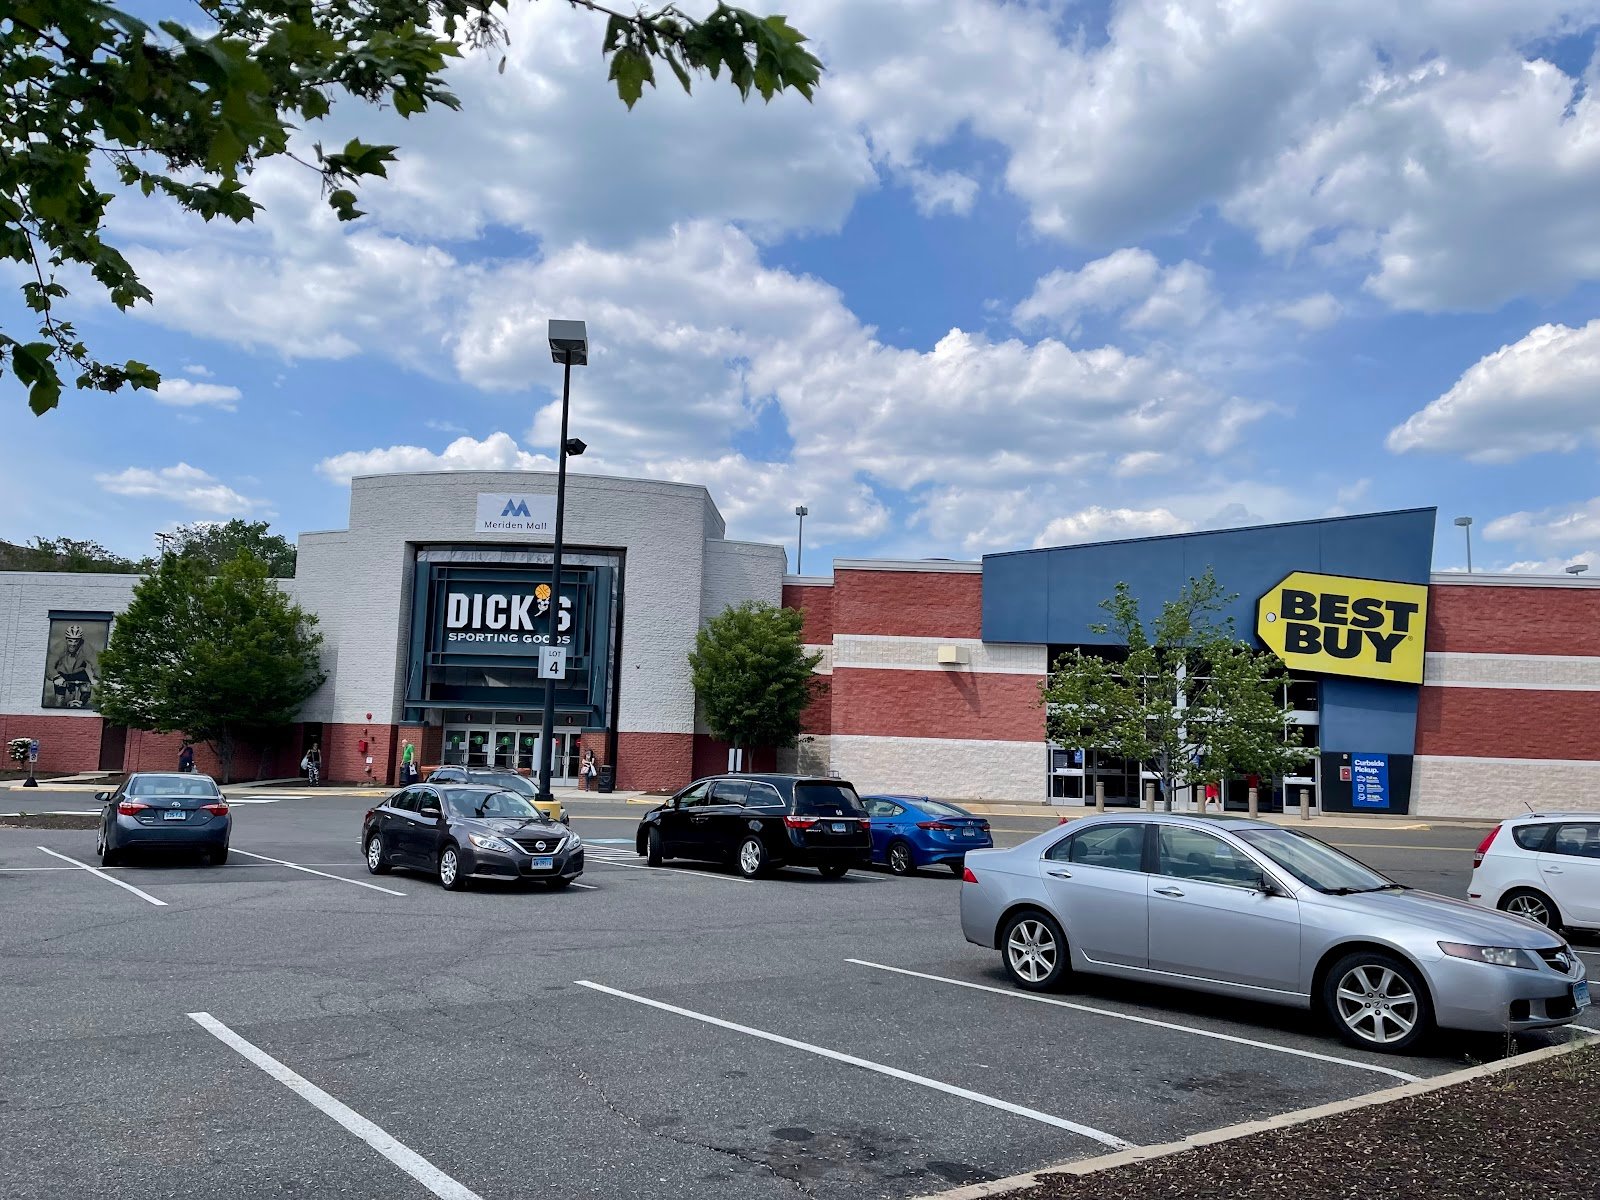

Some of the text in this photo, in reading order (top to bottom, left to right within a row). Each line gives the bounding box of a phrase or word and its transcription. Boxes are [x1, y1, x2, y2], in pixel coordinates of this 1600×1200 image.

[484, 521, 547, 530] Meriden Mall
[1280, 588, 1419, 633] BEST
[448, 632, 519, 642] SPORTING
[1284, 621, 1408, 664] BUY
[549, 661, 559, 675] 4
[1354, 759, 1385, 767] Curbside
[1354, 766, 1380, 775] Pickup.
